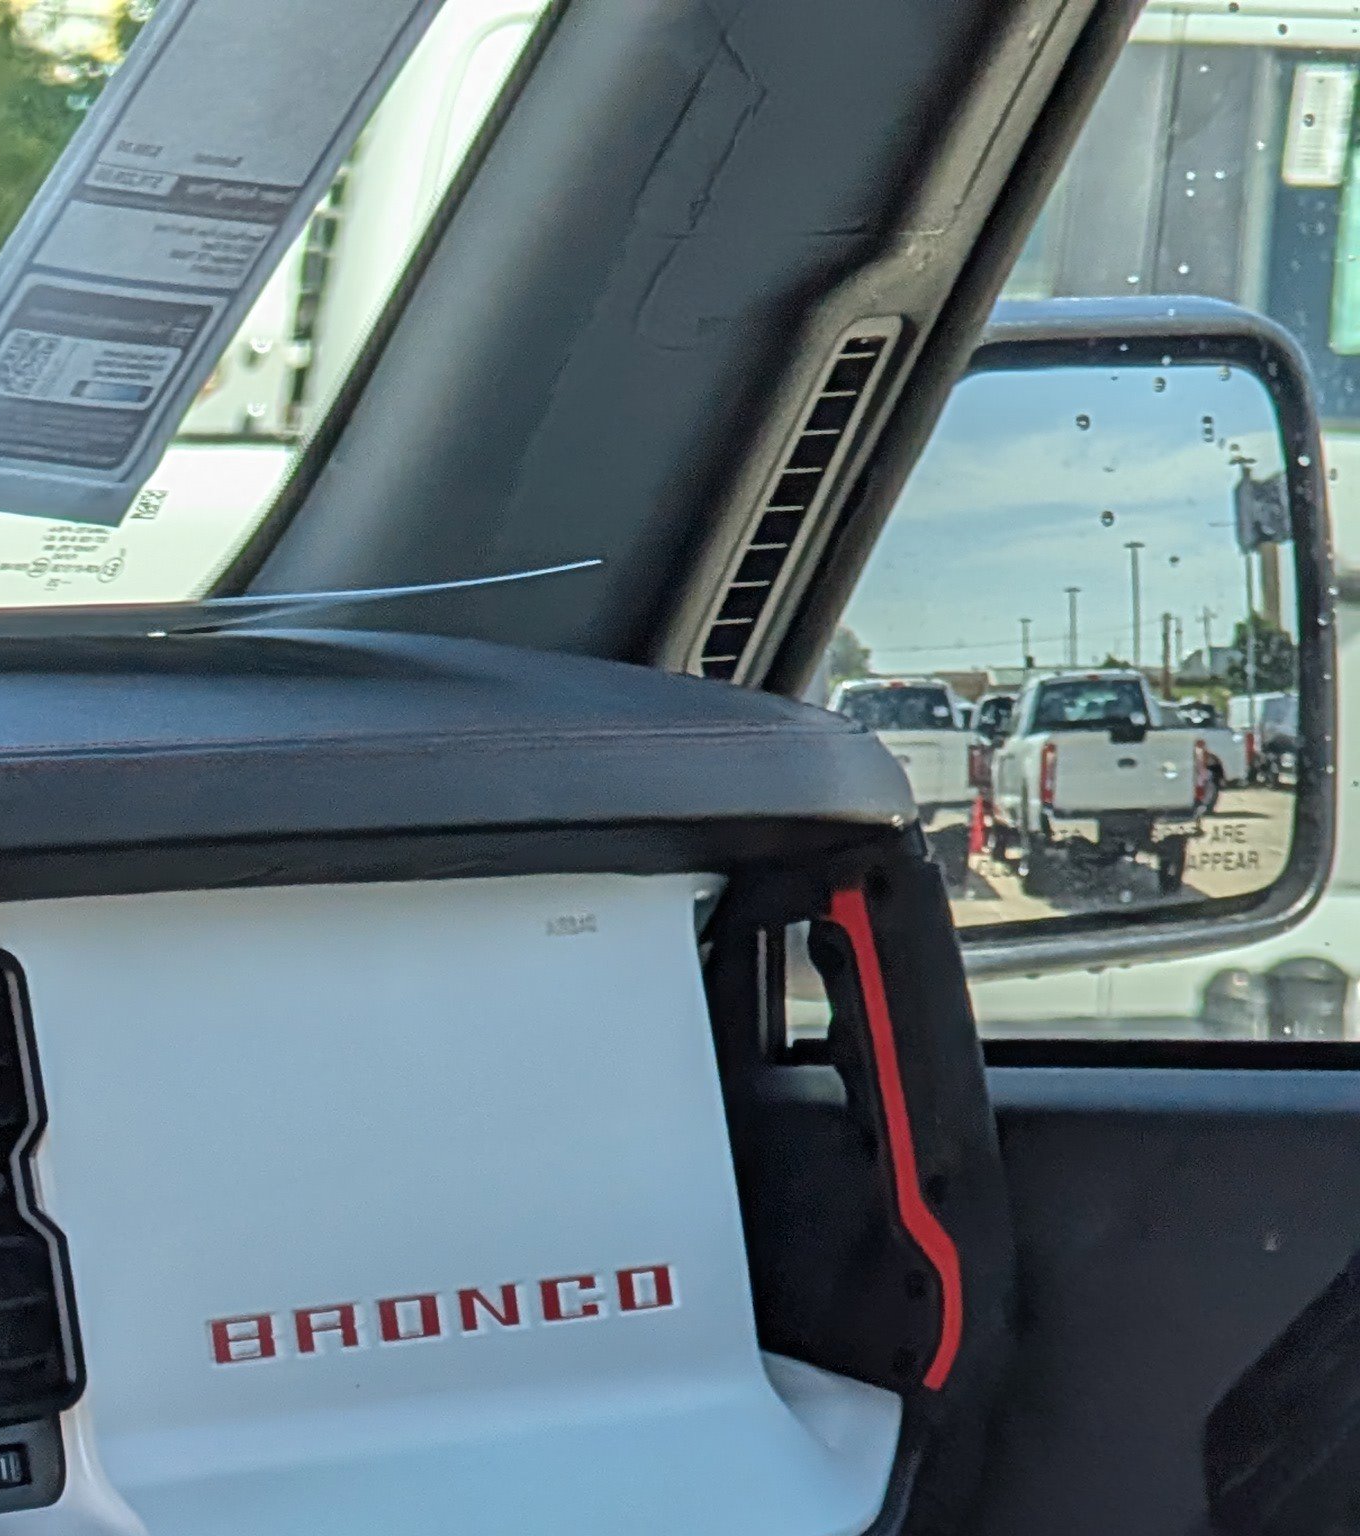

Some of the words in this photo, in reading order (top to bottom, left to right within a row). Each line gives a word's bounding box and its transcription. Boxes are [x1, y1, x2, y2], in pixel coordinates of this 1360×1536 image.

[1210, 823, 1248, 844] ARE
[1186, 850, 1261, 873] APPEAR
[209, 1264, 675, 1365] BRONCO
